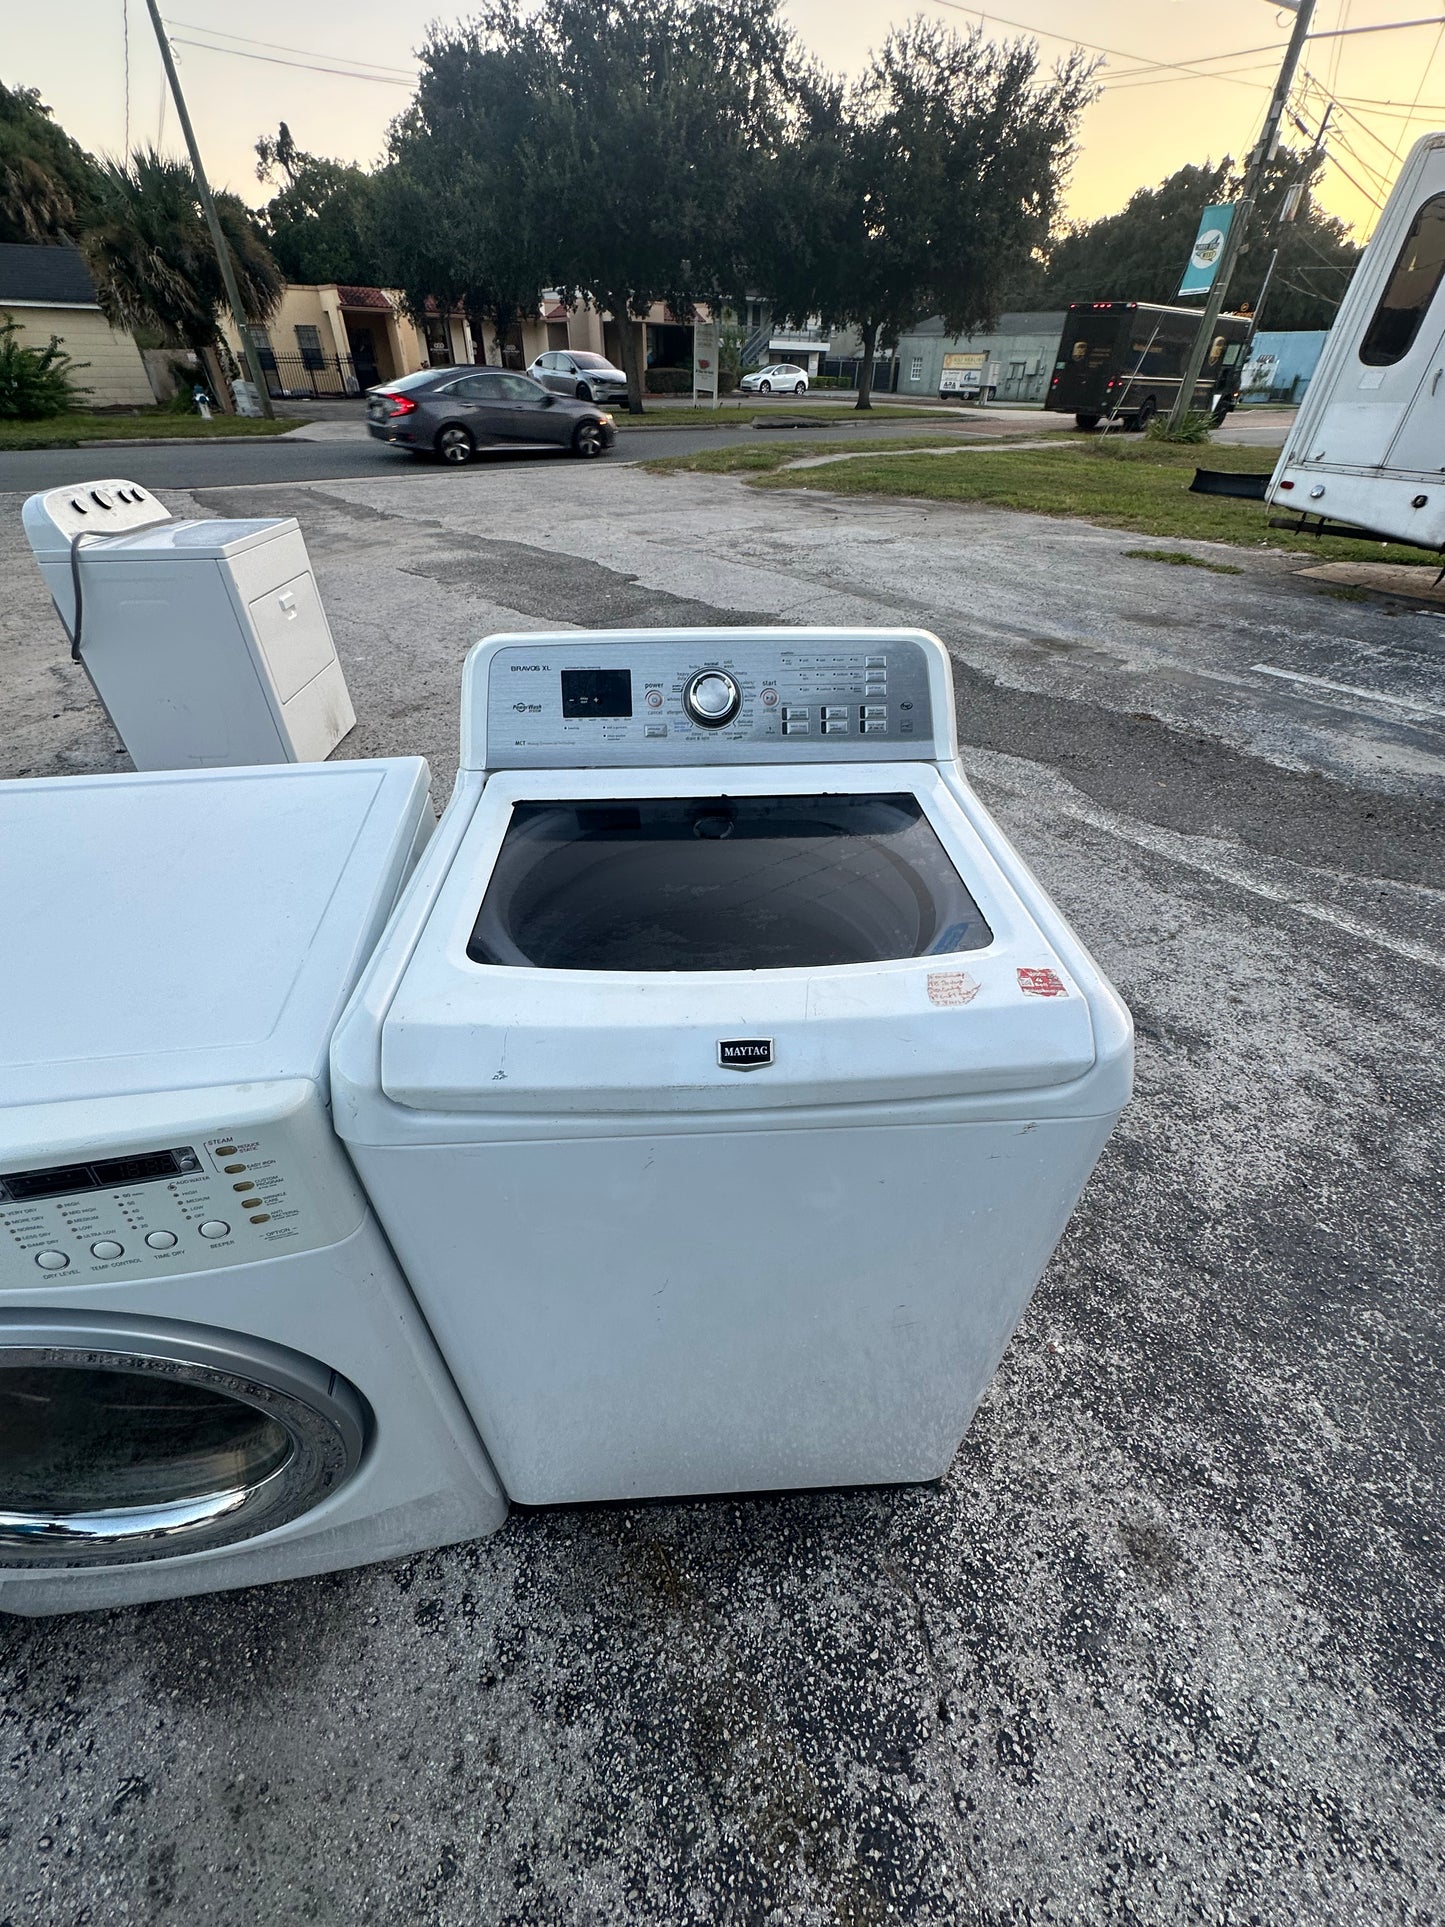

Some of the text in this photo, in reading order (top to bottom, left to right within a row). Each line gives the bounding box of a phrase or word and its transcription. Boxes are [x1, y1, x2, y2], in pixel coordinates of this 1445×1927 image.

[724, 1046, 768, 1057] MAYTAG
[208, 1137, 233, 1145] STEAM
[254, 1175, 279, 1183] CUSTOM
[256, 1178, 284, 1187] PROGRAM
[186, 1196, 210, 1204] MEDIUM
[262, 1191, 287, 1200] WRINKLE
[73, 1215, 99, 1223] MEDIUM
[265, 1227, 291, 1237] OPTION
[210, 1240, 235, 1249] BEEPER
[90, 1258, 143, 1272] TEMP CONTROL
[59, 1269, 81, 1277] LEVEL
